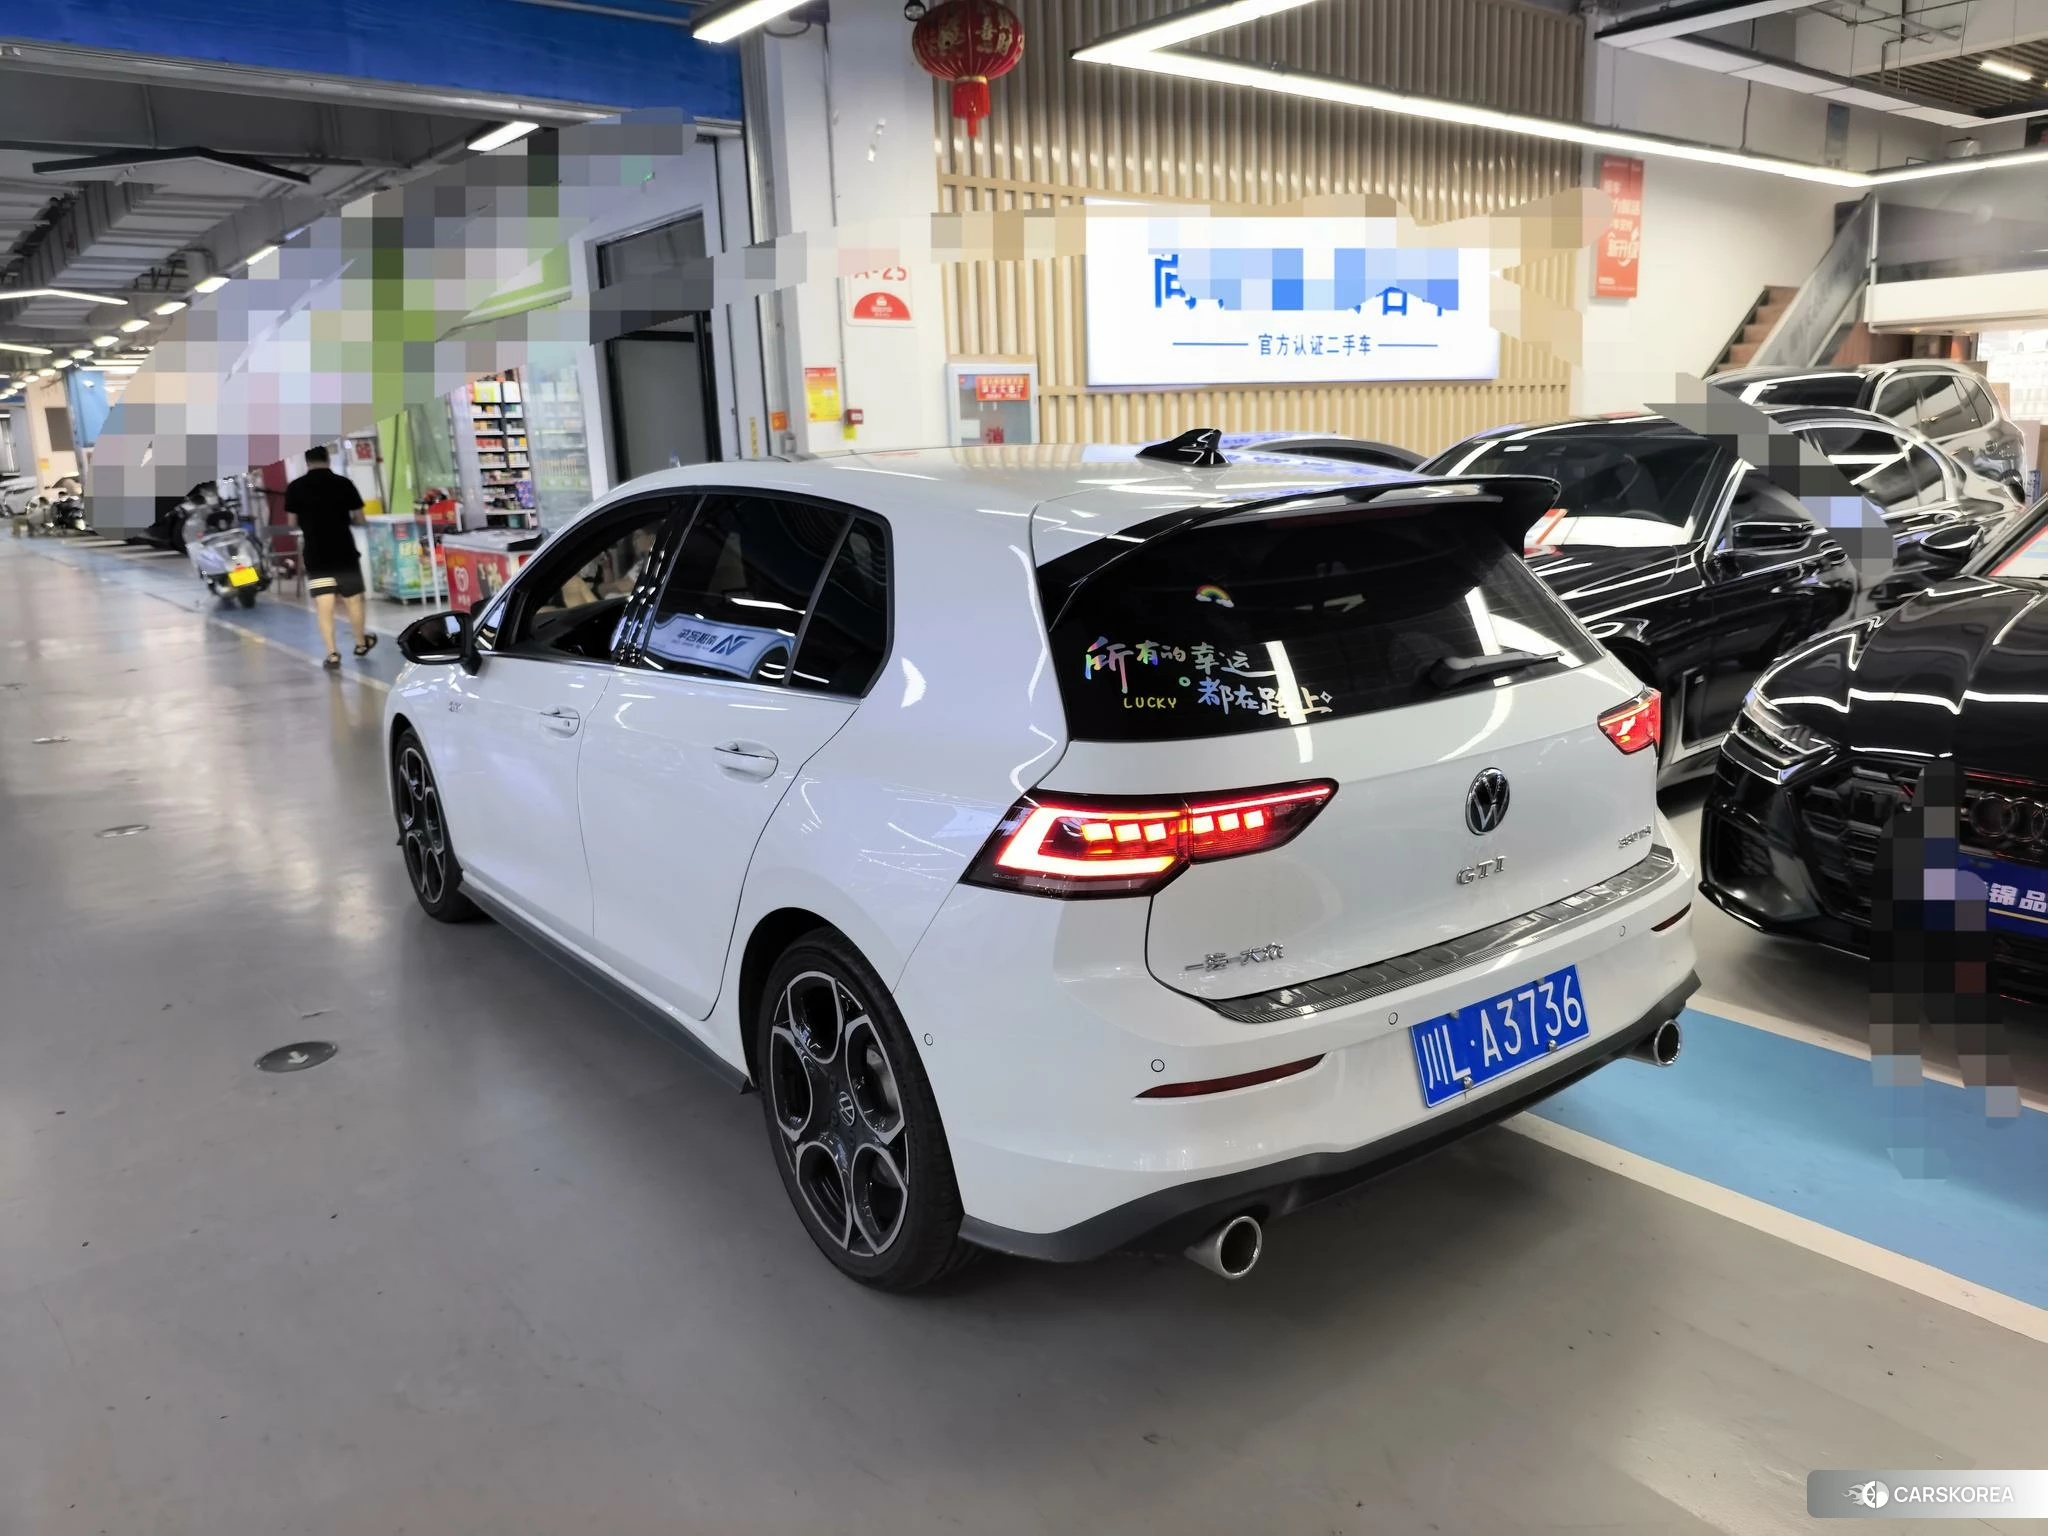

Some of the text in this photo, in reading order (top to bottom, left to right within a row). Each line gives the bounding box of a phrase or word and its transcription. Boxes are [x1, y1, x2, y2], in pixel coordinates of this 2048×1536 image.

[1258, 333, 1371, 357] 官方认证二手车
[1084, 636, 1277, 693] 所有的幸运
[1123, 696, 1177, 709] LUCKY
[1456, 855, 1507, 885] GTI
